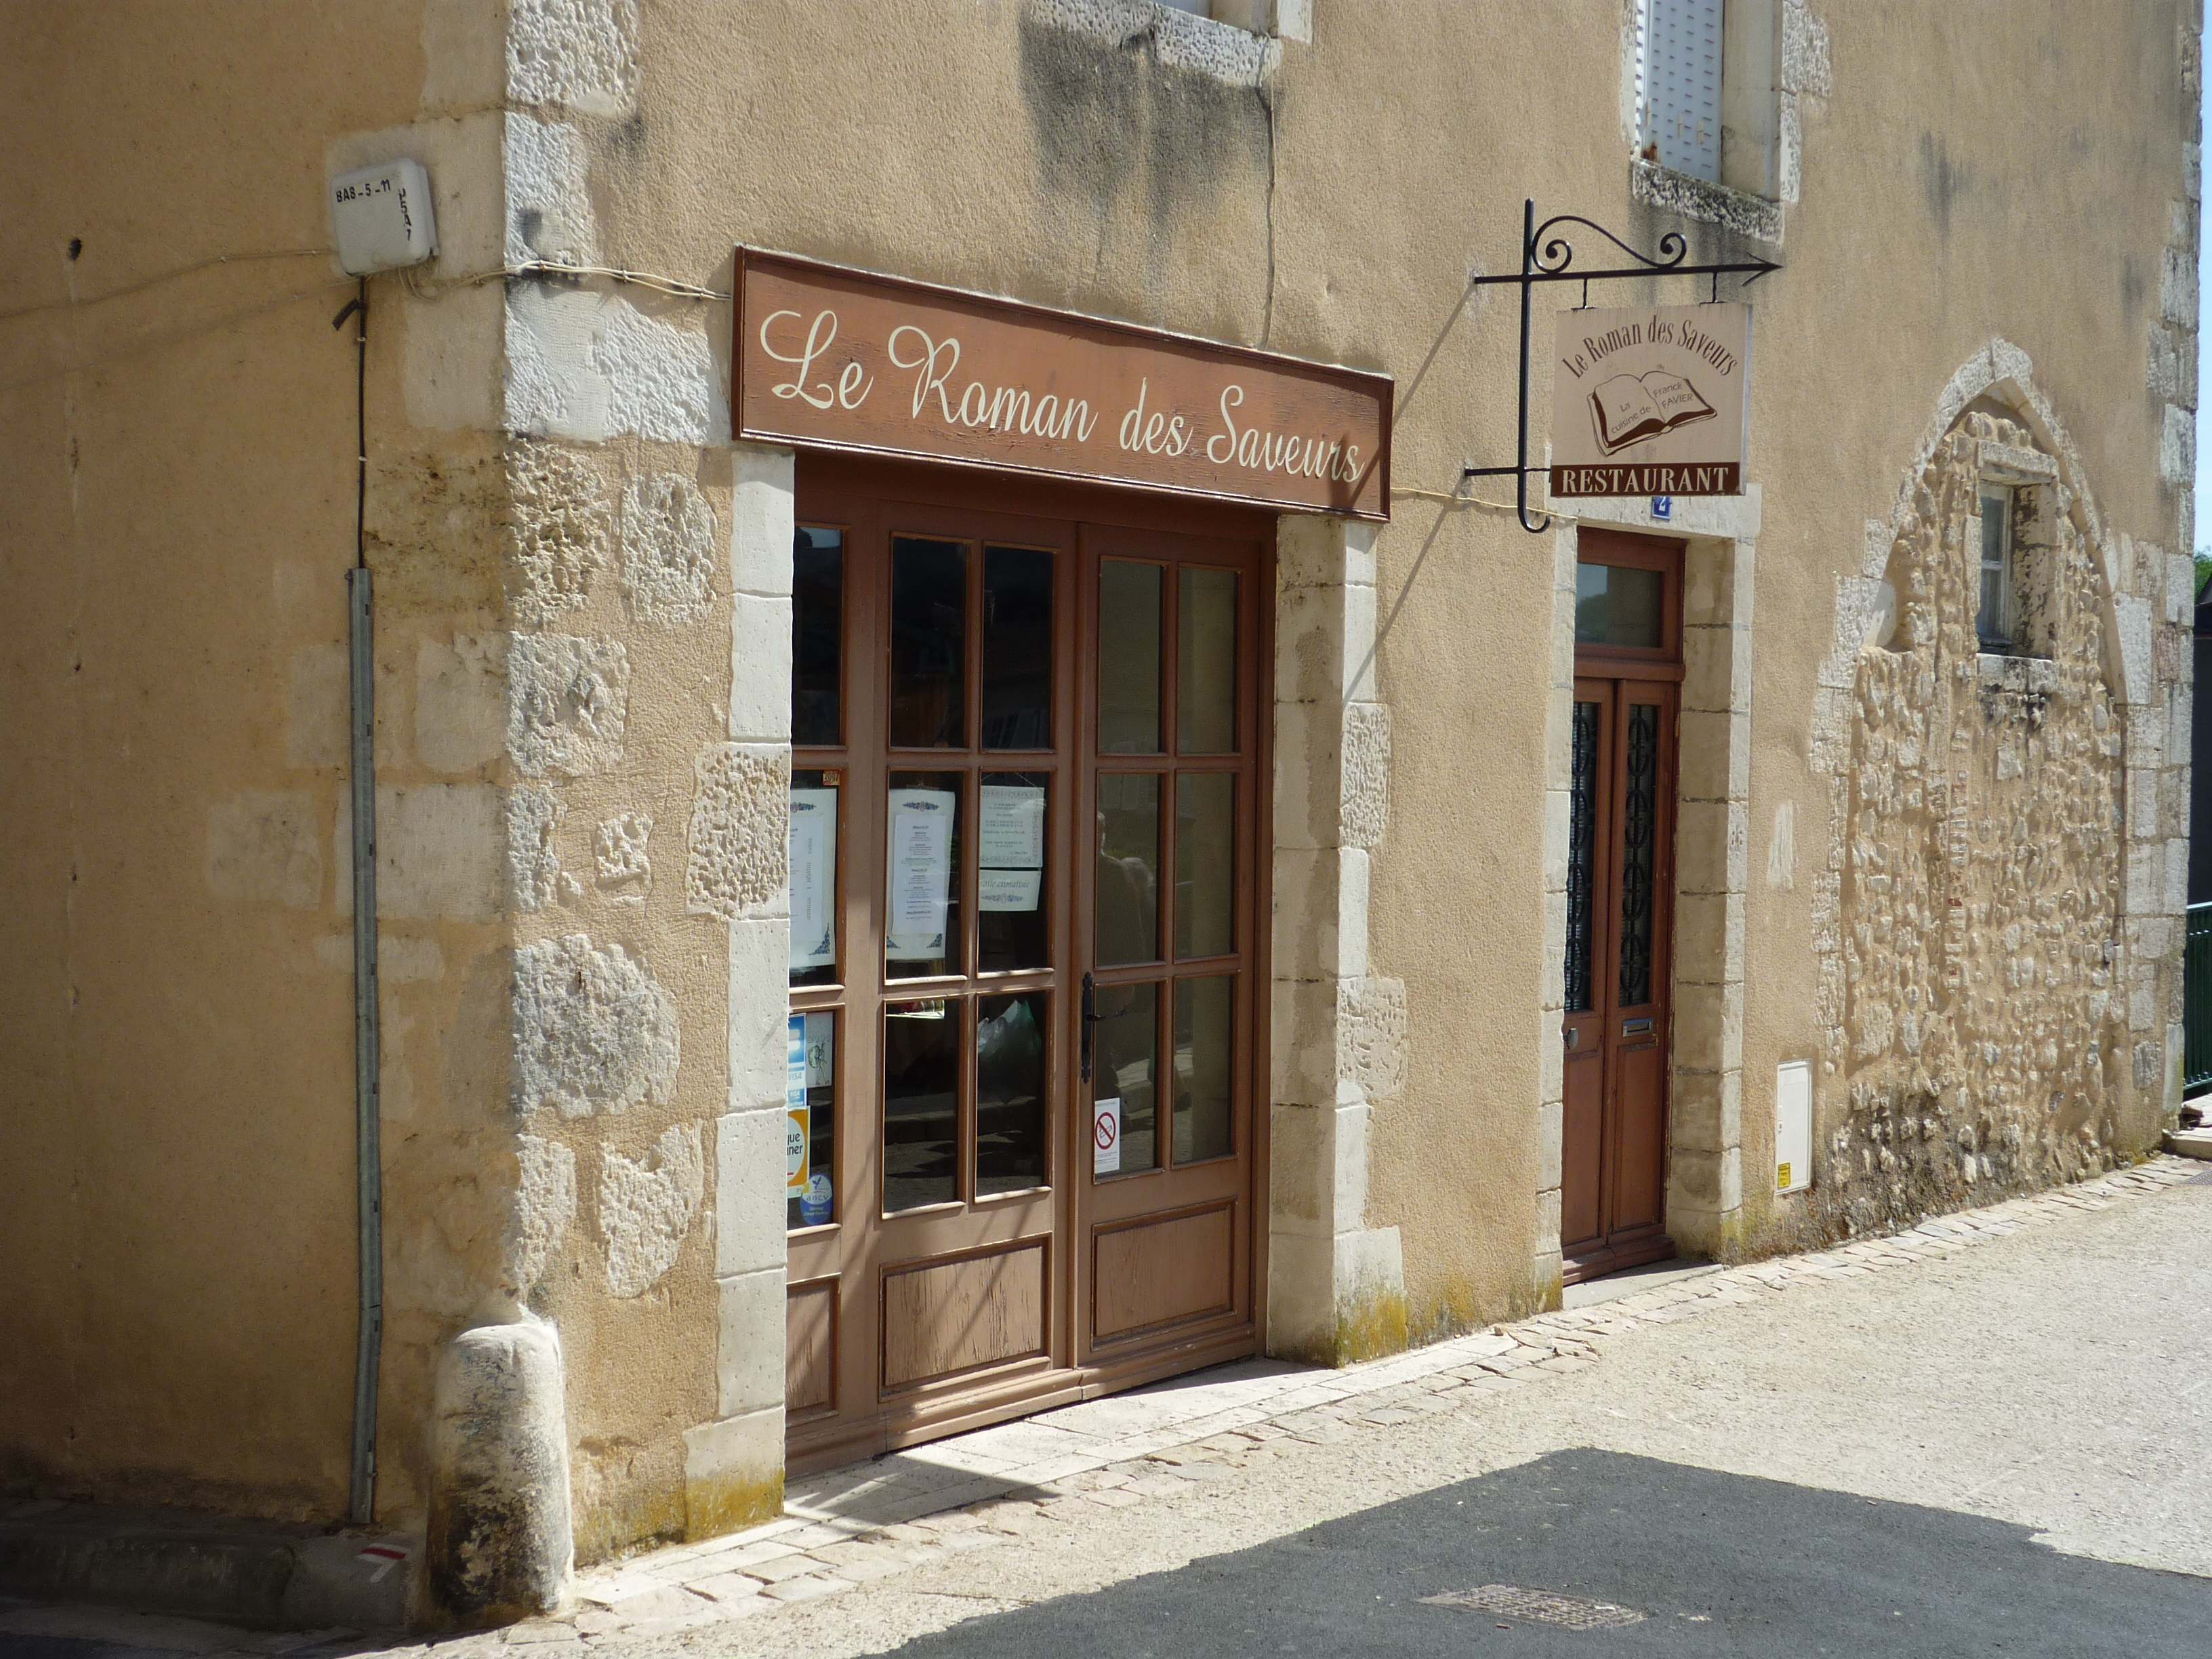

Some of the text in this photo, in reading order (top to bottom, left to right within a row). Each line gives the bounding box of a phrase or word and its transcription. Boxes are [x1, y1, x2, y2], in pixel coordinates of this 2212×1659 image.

[1561, 314, 1737, 380] Le Roman des Saveurs
[760, 310, 1366, 483] Le Roman des Saveurs
[1653, 382, 1682, 398] Franck
[1620, 403, 1631, 413] La
[1662, 393, 1693, 409] FAVIER
[1611, 405, 1651, 434] cuisine de
[1562, 467, 1728, 493] RESTAURANT
[788, 1072, 802, 1081] VISA
